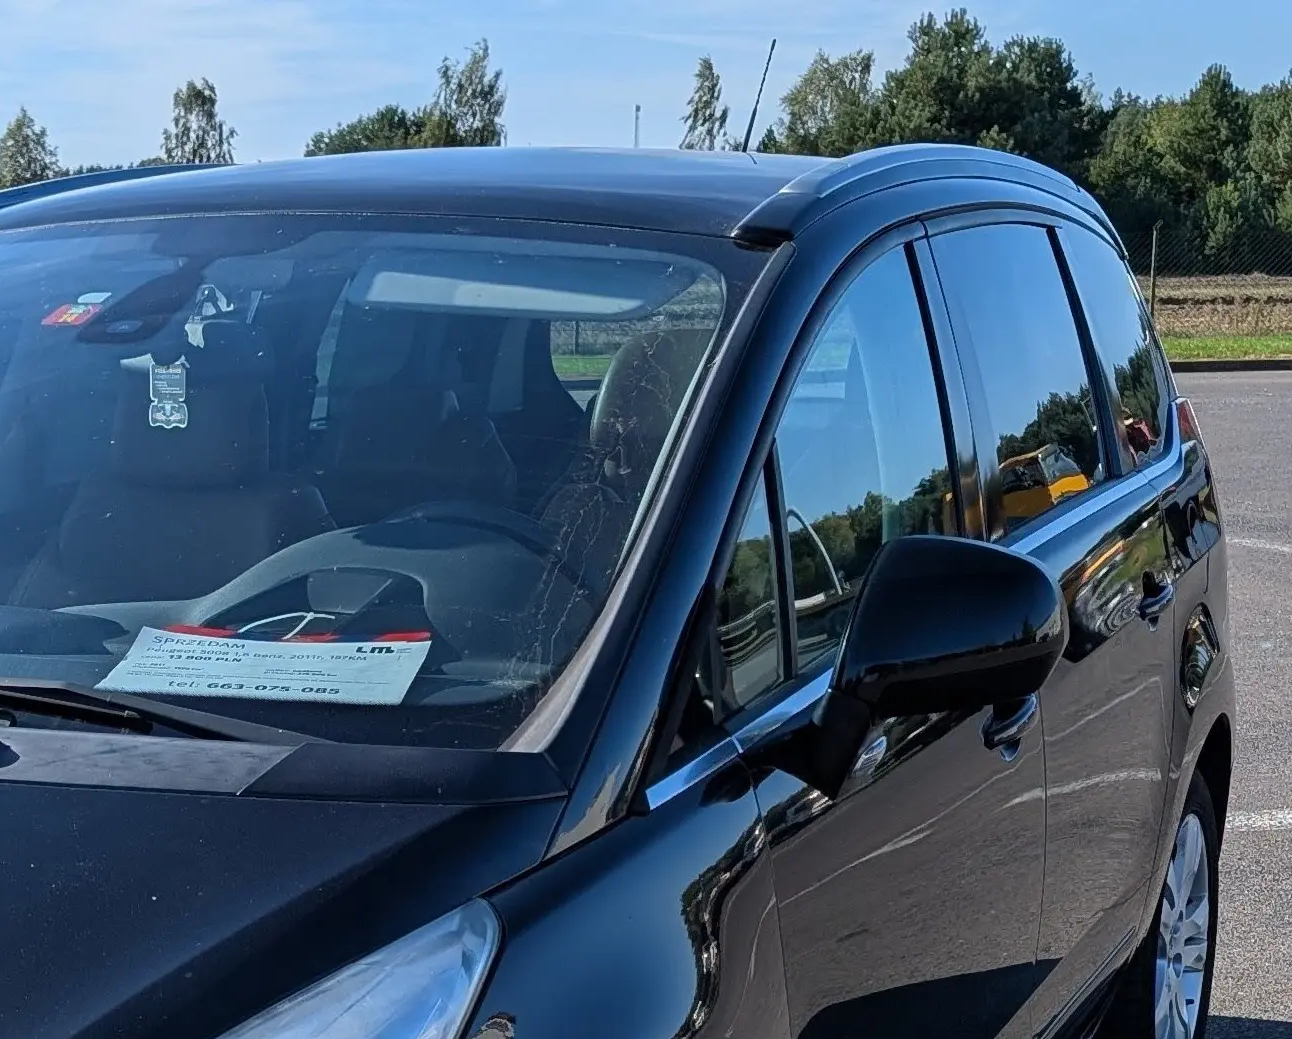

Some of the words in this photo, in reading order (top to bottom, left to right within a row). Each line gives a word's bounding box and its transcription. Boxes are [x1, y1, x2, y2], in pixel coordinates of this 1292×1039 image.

[152, 636, 246, 650] SPRZEDAM
[146, 646, 197, 655] Peugeot
[206, 682, 341, 695] 663-075-085
